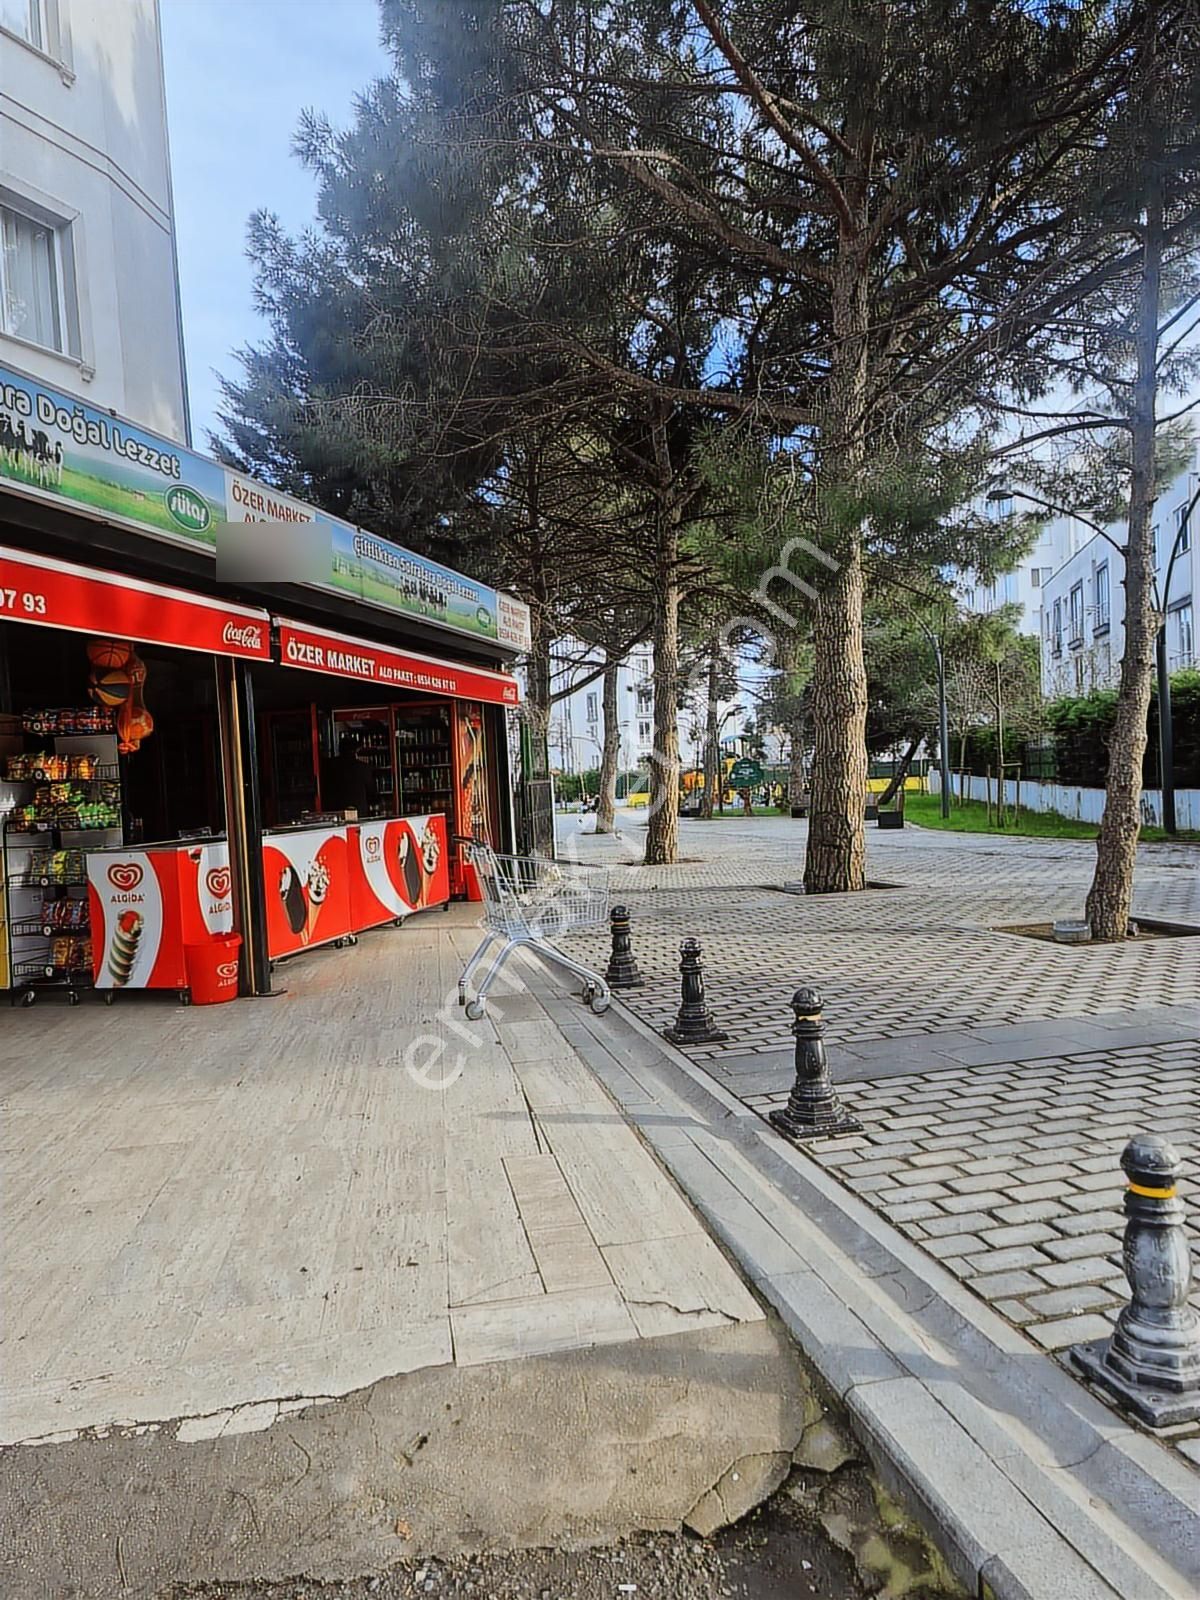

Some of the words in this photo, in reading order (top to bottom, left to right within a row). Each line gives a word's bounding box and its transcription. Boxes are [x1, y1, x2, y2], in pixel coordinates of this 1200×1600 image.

[37, 394, 111, 450] Doğal
[112, 427, 180, 480] Lezzet
[232, 480, 265, 513] ÖZER
[22, 592, 47, 615] 93
[223, 621, 261, 649] Coca-Cola
[287, 637, 325, 667] ÖZER
[327, 650, 375, 677] MARKET
